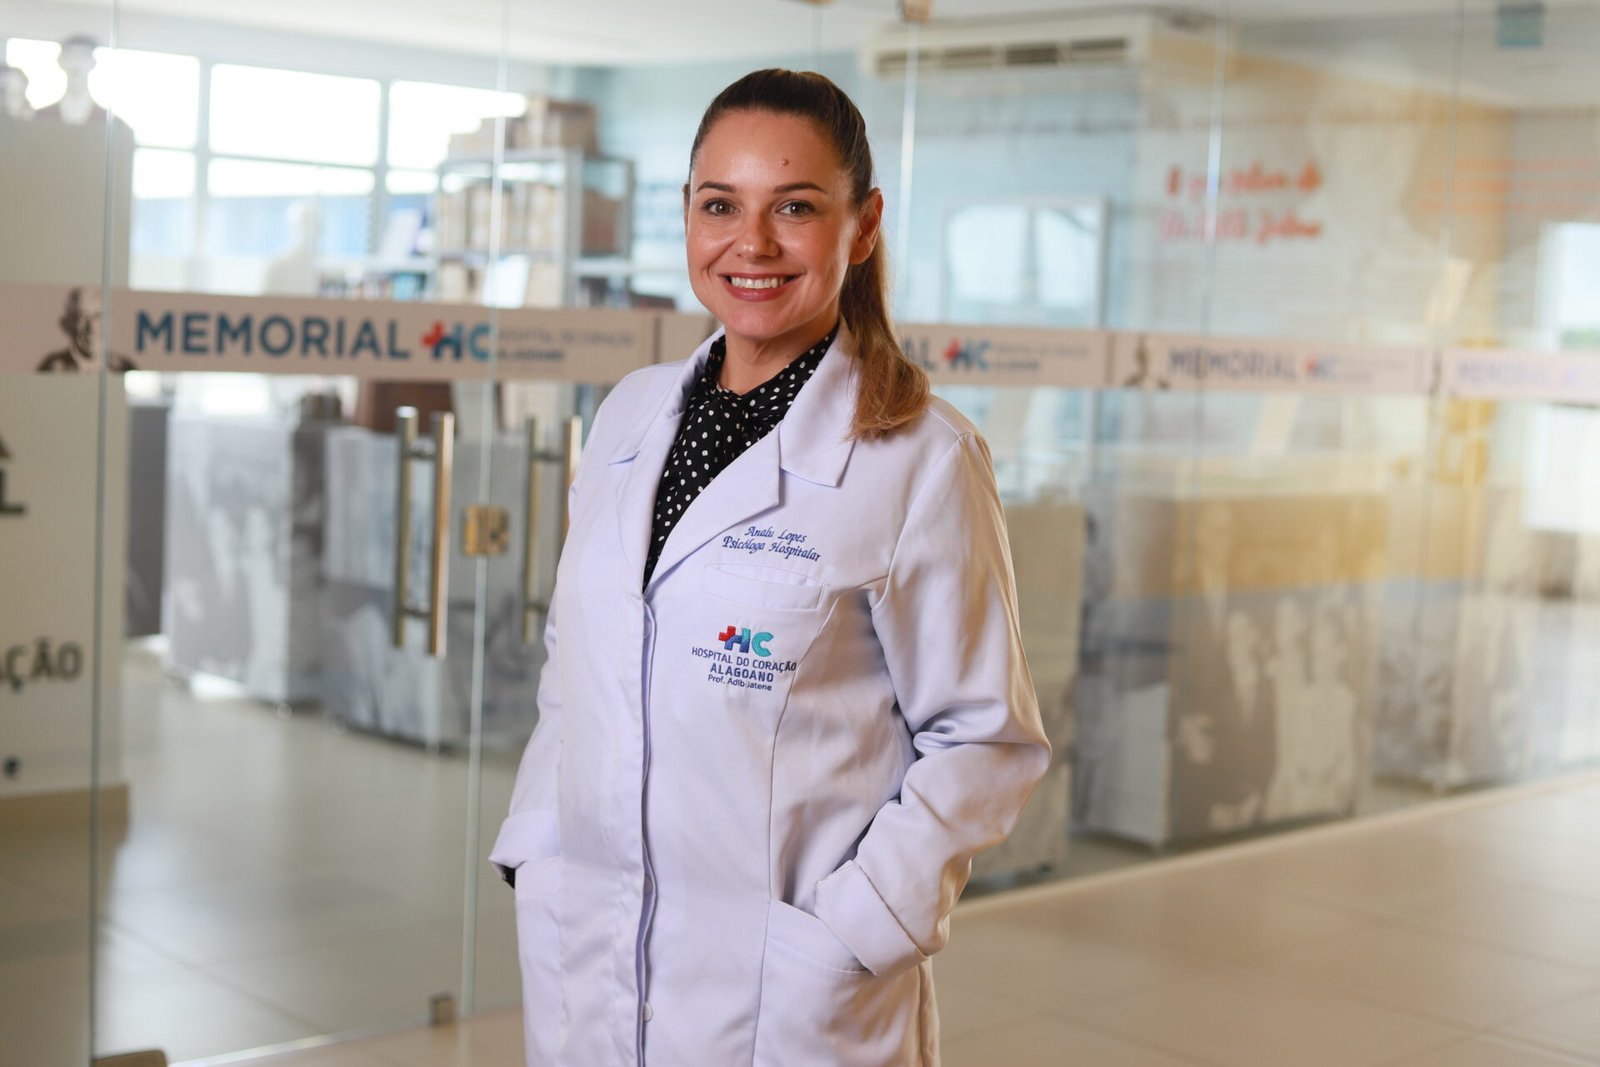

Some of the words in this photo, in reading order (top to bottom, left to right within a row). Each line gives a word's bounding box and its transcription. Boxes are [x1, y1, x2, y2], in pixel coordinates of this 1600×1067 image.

[135, 310, 412, 361] MEMORIAL
[744, 525, 775, 538] Analu
[777, 529, 808, 543] Lopes
[722, 535, 766, 554] Psicóloga
[768, 541, 821, 562] Hospitalar
[718, 625, 774, 658] HC
[0, 636, 84, 694] ÇÃO
[691, 646, 733, 665] HOSPITAL
[736, 655, 750, 667] DO
[752, 659, 797, 674] CORAÇÃO
[710, 663, 774, 683] ALAGOANO
[708, 674, 726, 685] Prof.
[727, 677, 746, 688] Adib
